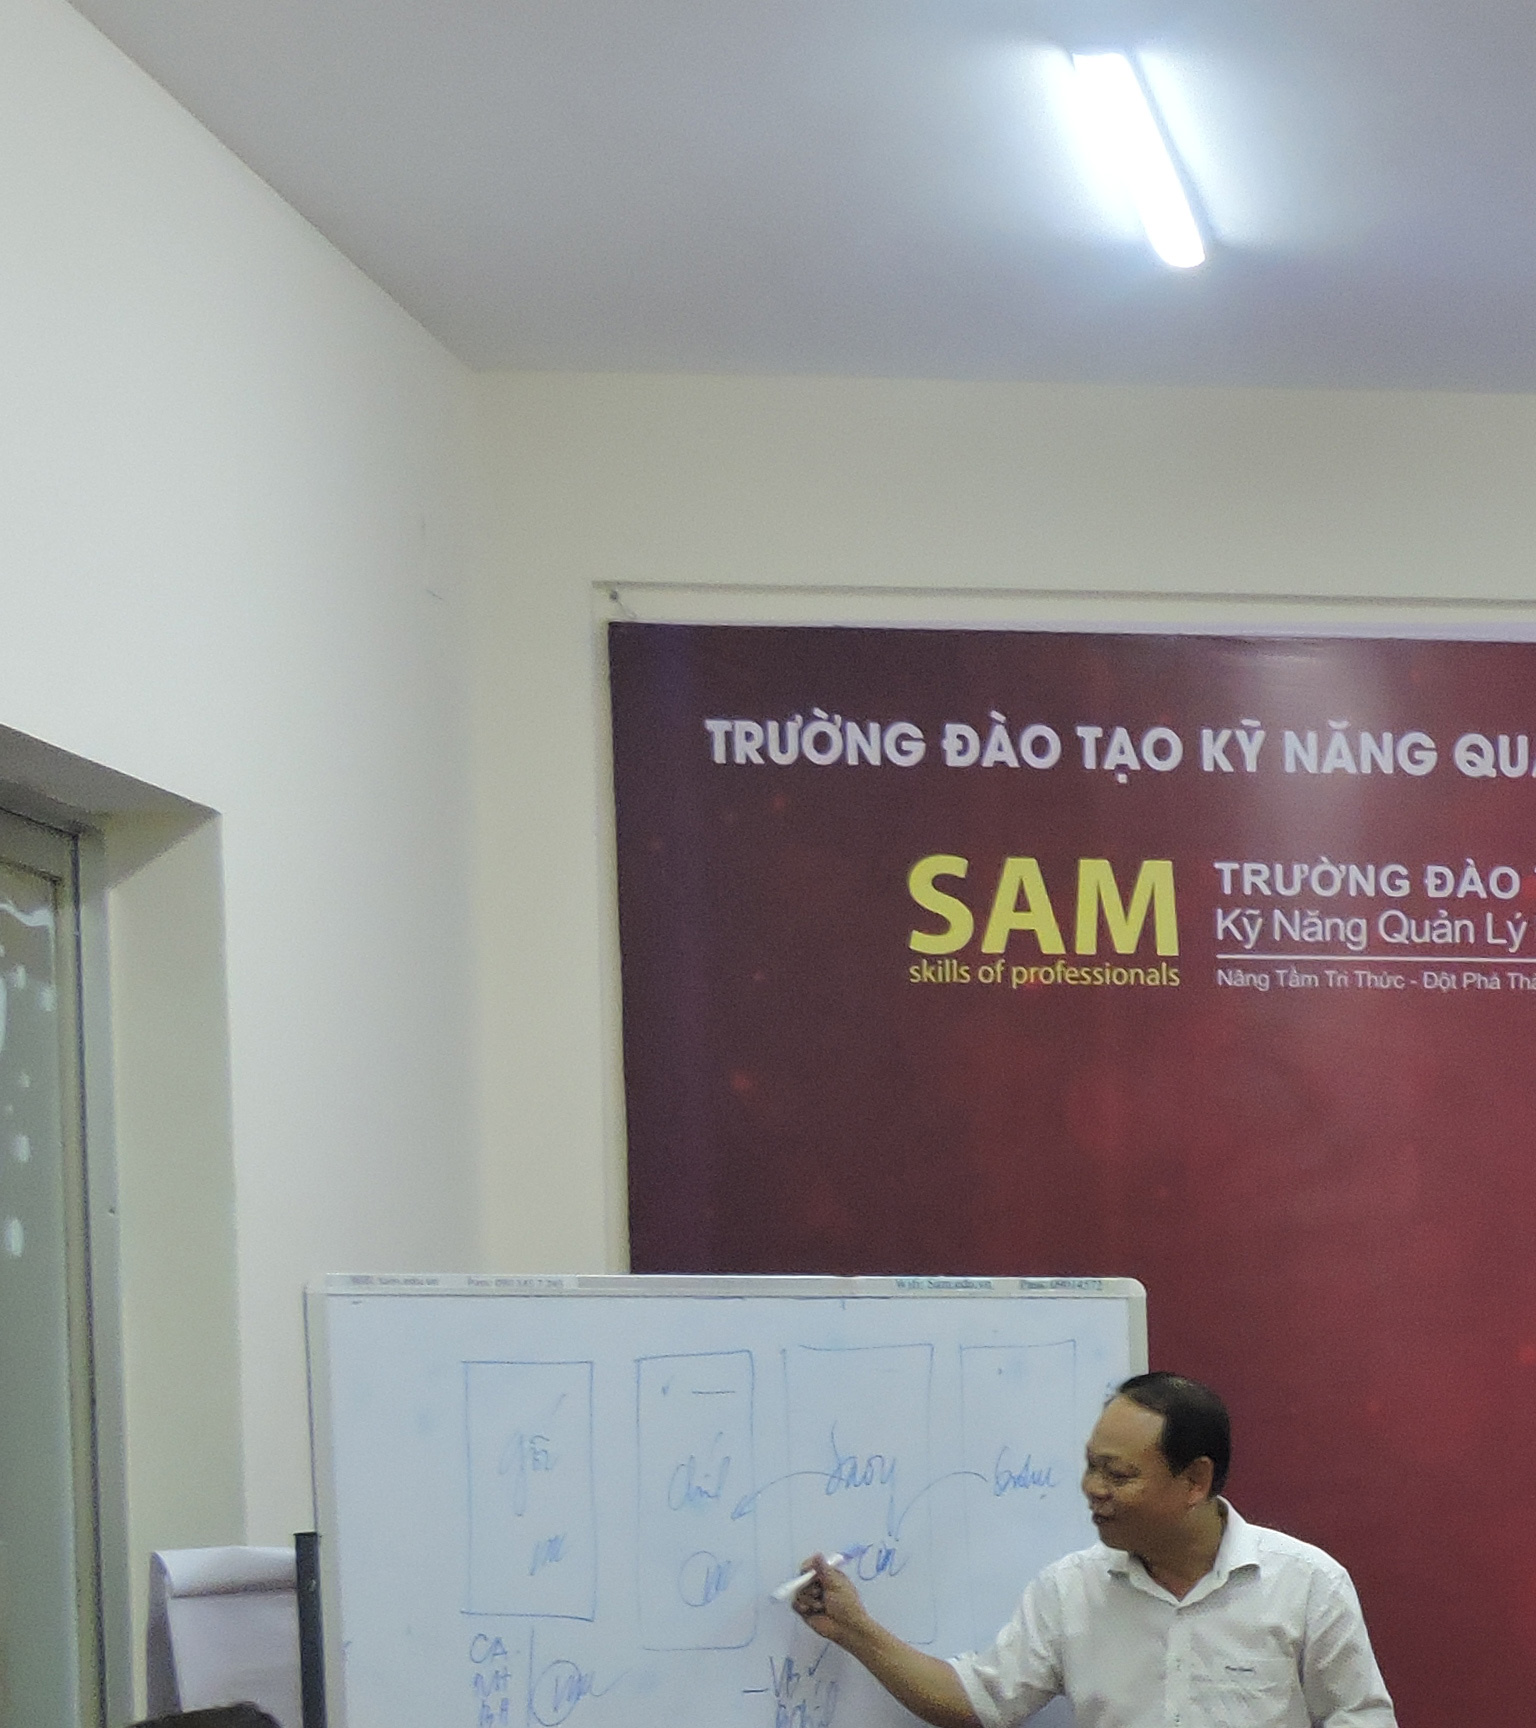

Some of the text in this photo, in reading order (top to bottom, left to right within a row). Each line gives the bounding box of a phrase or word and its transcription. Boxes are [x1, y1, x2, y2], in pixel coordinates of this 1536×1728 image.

[705, 708, 926, 766] TRƯỜNG
[942, 711, 1061, 769] ĐÀO
[1077, 726, 1183, 783] TẠO
[1202, 719, 1266, 772] KỸ
[1284, 719, 1437, 775] NĂNG
[1214, 856, 1409, 897] TRƯỜNG
[1424, 858, 1520, 899] ĐÀO
[909, 855, 1179, 956] SAM
[1217, 909, 1263, 949] Kỹ
[1274, 909, 1367, 951] Năng
[1378, 910, 1474, 944] Quản
[1487, 912, 1527, 953] Lý
[910, 959, 1180, 989] skills of professionals
[1218, 969, 1269, 991] Nâng
[1275, 966, 1319, 987] Tầm
[1324, 970, 1348, 987] Tri
[1353, 970, 1405, 989] Thức
[1423, 972, 1457, 992] Đột
[1462, 972, 1501, 990] Phá
